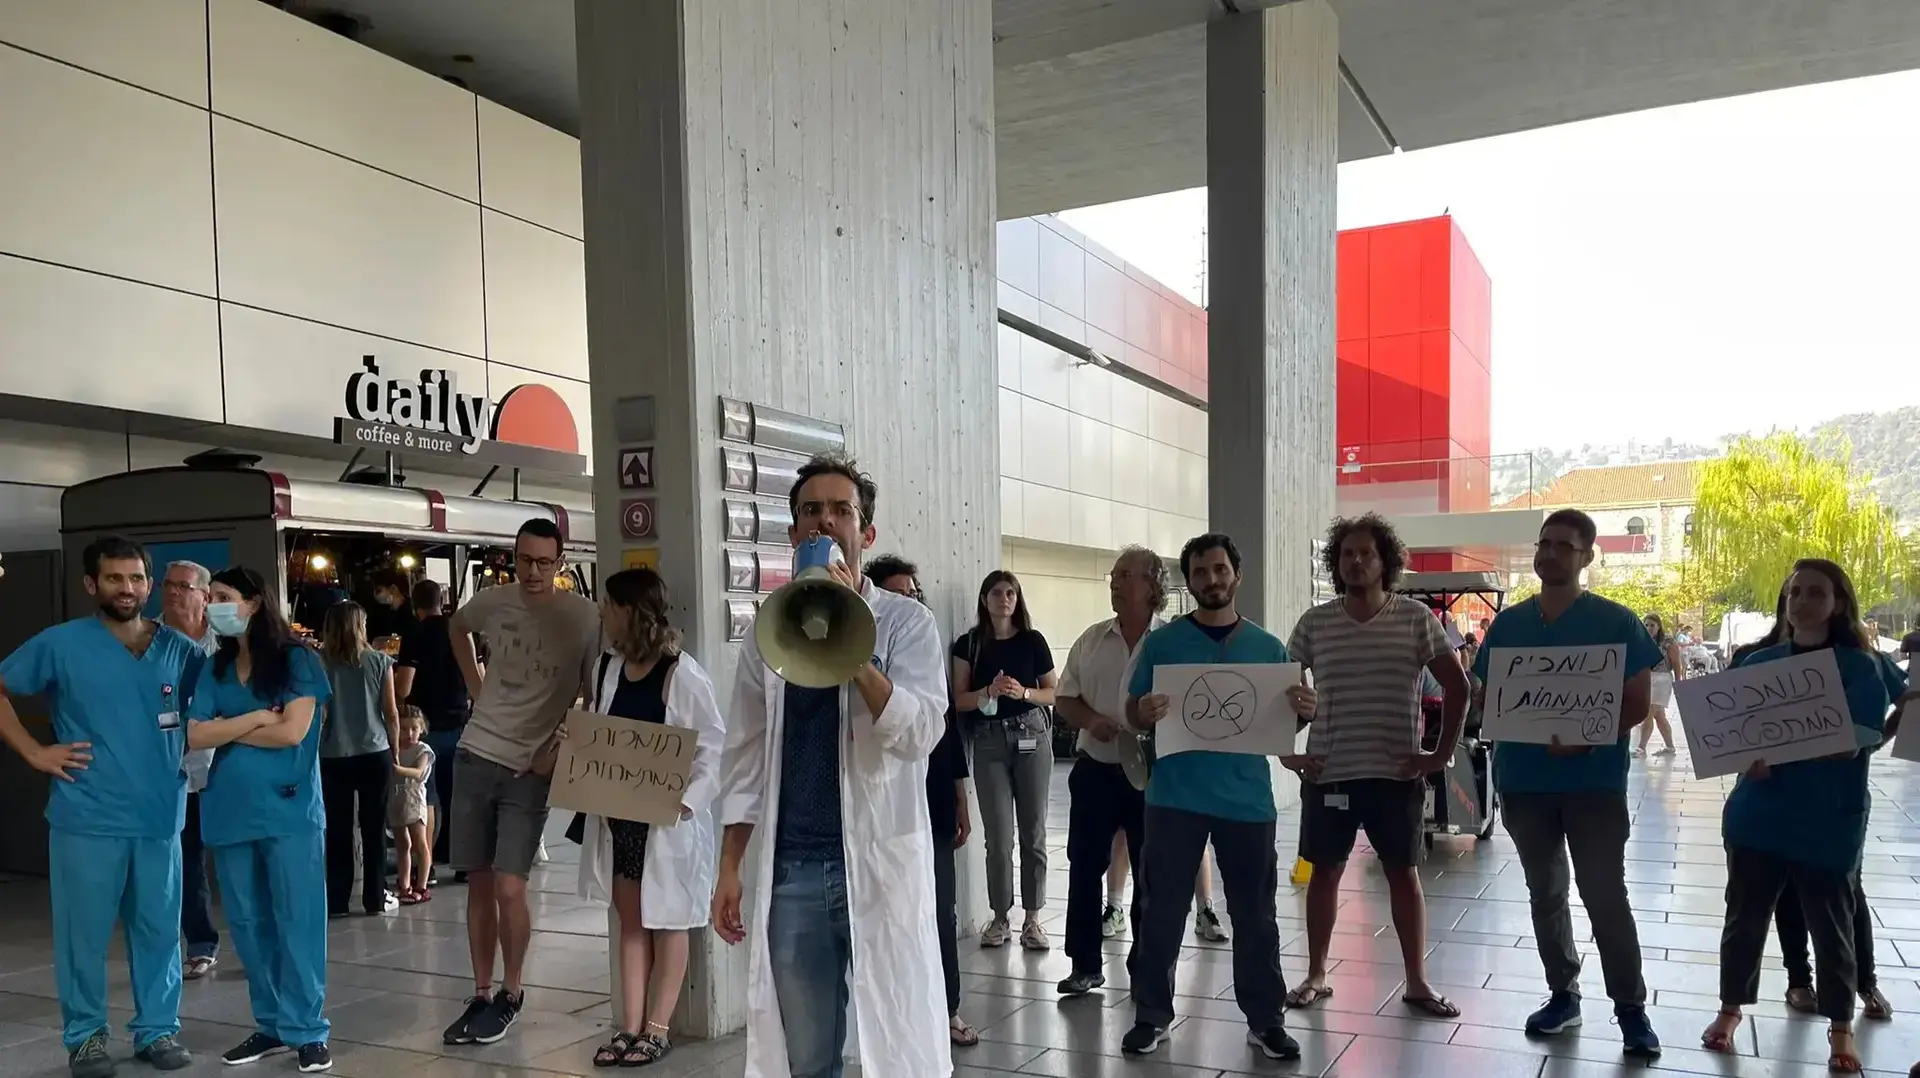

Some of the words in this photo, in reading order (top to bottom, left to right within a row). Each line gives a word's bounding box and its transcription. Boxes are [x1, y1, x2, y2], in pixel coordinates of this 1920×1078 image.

[348, 356, 493, 454] daily
[356, 425, 400, 446] coffee
[404, 431, 415, 447] &
[418, 436, 453, 452] more
[632, 510, 643, 528] 9
[1506, 649, 1617, 678] תומכים
[1191, 690, 1246, 721] 26
[1706, 668, 1825, 712] תומכים
[574, 727, 682, 758] תומכות
